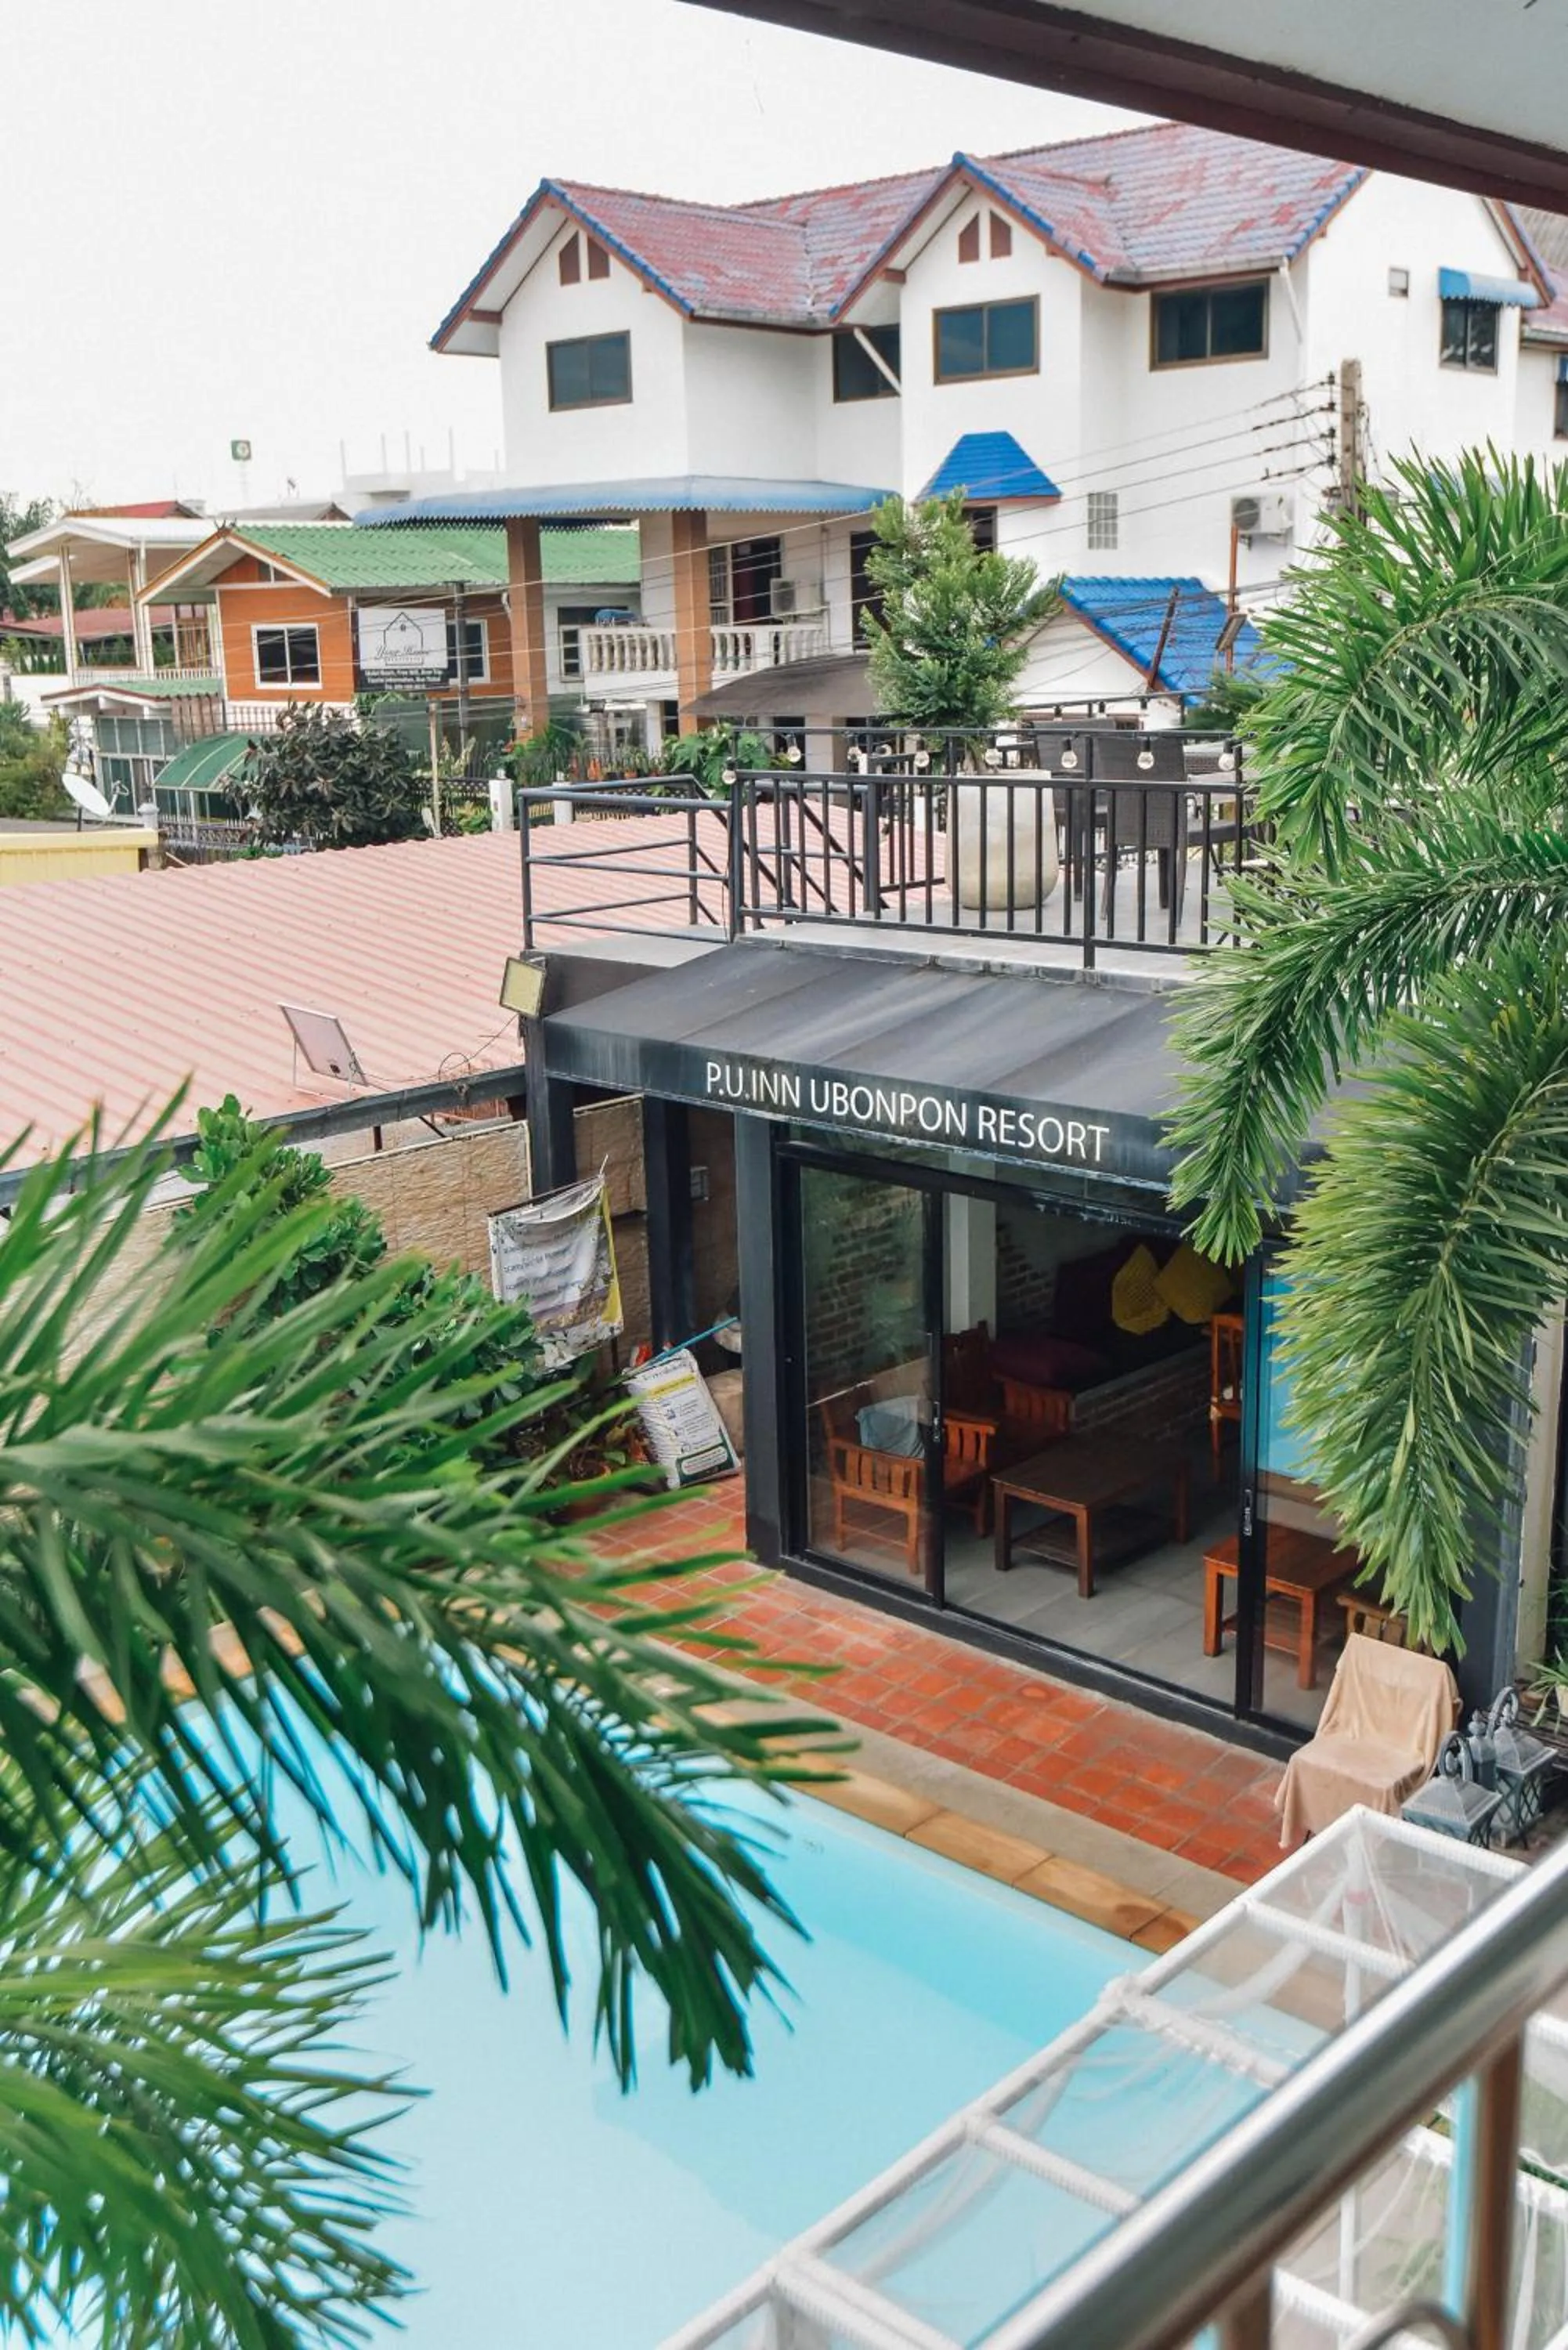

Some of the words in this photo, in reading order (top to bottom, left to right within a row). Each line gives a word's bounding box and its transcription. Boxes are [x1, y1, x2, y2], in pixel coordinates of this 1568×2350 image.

[706, 1061, 800, 1108] P.U.INN
[810, 1078, 966, 1137] UBONPON
[977, 1105, 1110, 1162] RESORT
